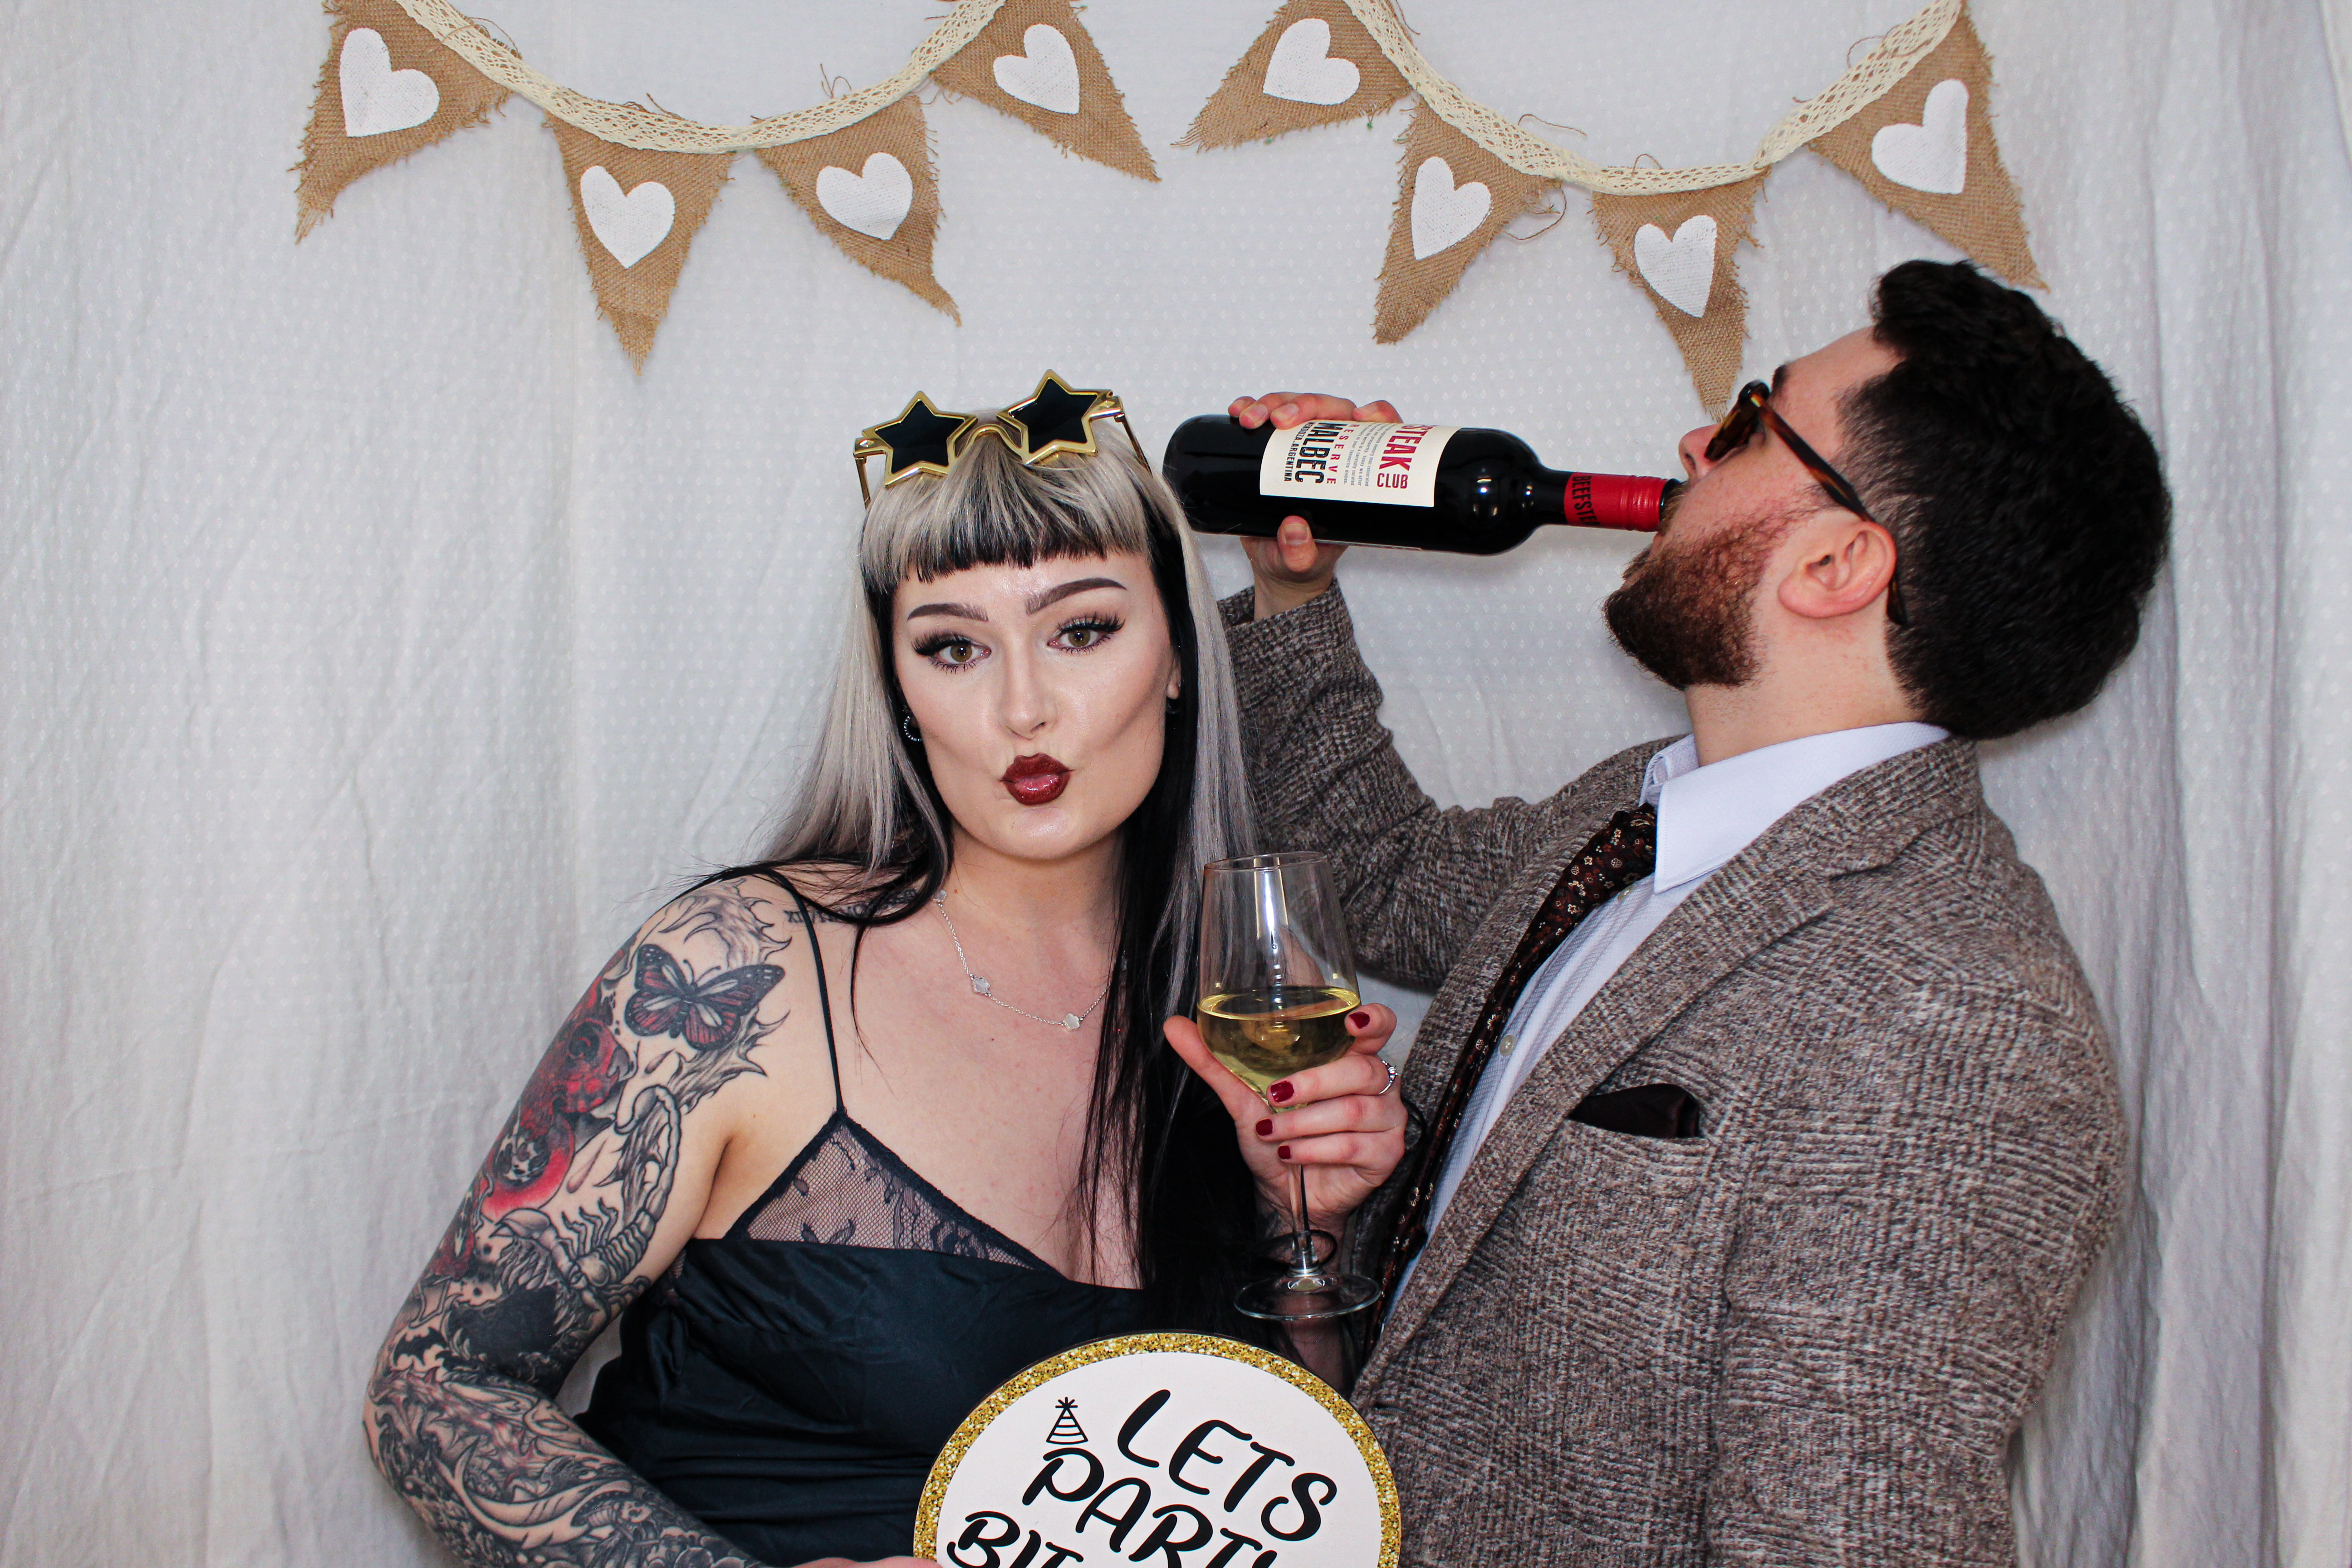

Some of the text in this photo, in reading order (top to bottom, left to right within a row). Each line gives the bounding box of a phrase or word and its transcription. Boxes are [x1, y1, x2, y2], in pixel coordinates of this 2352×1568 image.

[1295, 422, 1348, 484] MALBEC
[1326, 424, 1360, 484] RESERVE
[1379, 425, 1437, 471] STEAK
[1377, 473, 1409, 489] CLUB
[1117, 1389, 1338, 1541] LETS
[1022, 1447, 1277, 1568] PART
